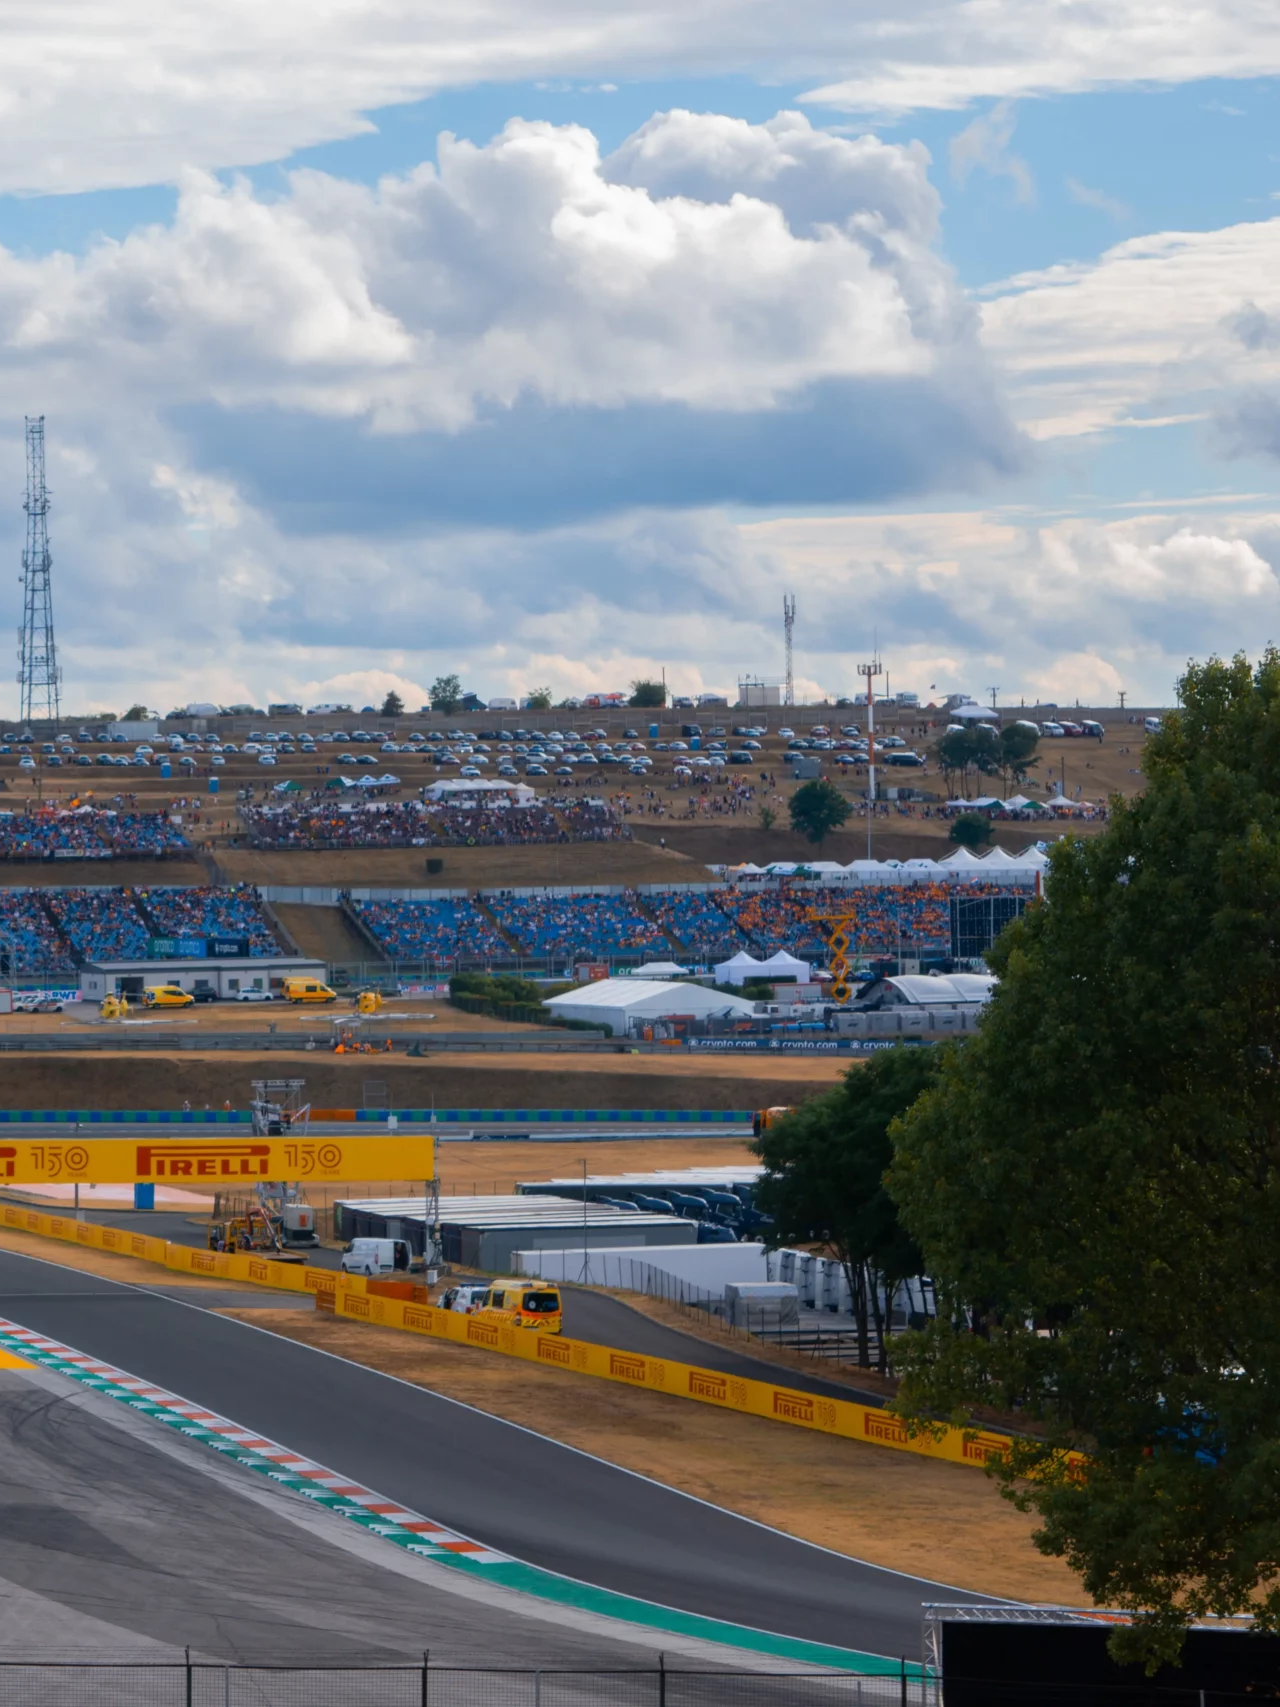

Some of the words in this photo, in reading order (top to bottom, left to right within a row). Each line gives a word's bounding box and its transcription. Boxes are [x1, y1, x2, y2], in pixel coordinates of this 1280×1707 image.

[52, 991, 76, 1000] BWT
[701, 1039, 757, 1047] crypto.com
[782, 1041, 838, 1049] crypto.com
[31, 1146, 89, 1178] 150
[136, 1145, 270, 1176] PIRELLI
[284, 1144, 342, 1175] 150
[344, 1293, 370, 1317] PIRELLI
[403, 1306, 432, 1332] PIRELLI
[467, 1319, 498, 1346] PIRELLI
[537, 1337, 570, 1364] PIRELLI
[610, 1353, 645, 1382] PIRELLI
[688, 1371, 727, 1401] PIRELLI
[773, 1391, 813, 1422] PIRELLI
[864, 1412, 908, 1444] PIRELLI
